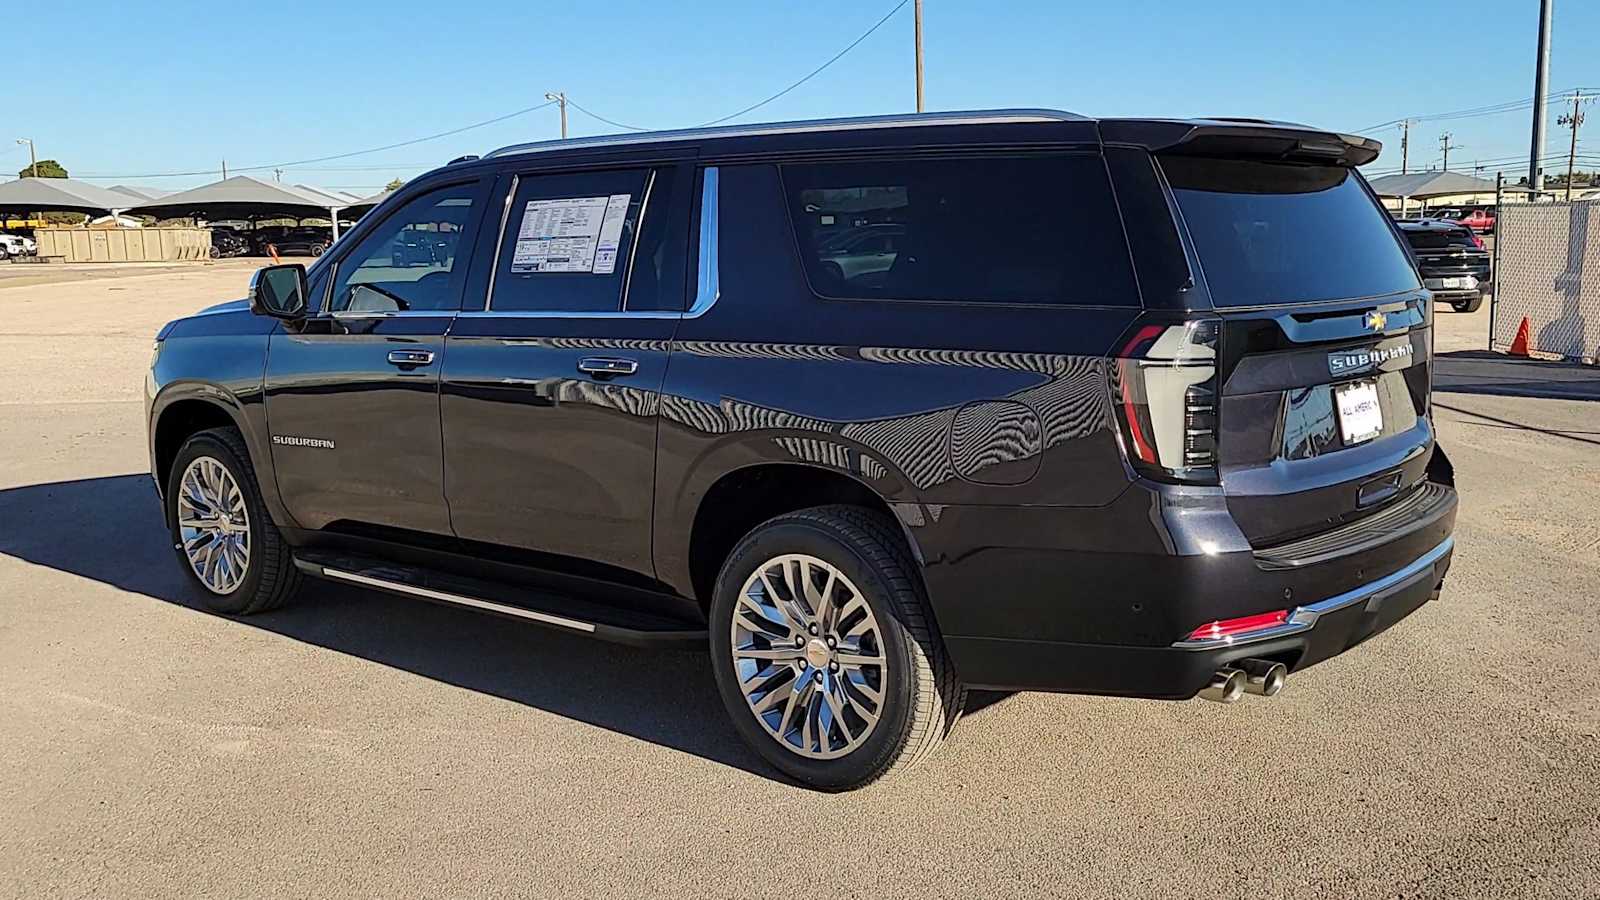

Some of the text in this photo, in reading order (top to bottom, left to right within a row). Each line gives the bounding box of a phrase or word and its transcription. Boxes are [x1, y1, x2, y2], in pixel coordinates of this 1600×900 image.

[1331, 344, 1414, 370] SUBURBAN
[1354, 400, 1378, 413] AMERICN
[273, 435, 335, 449] SUBURBAN
